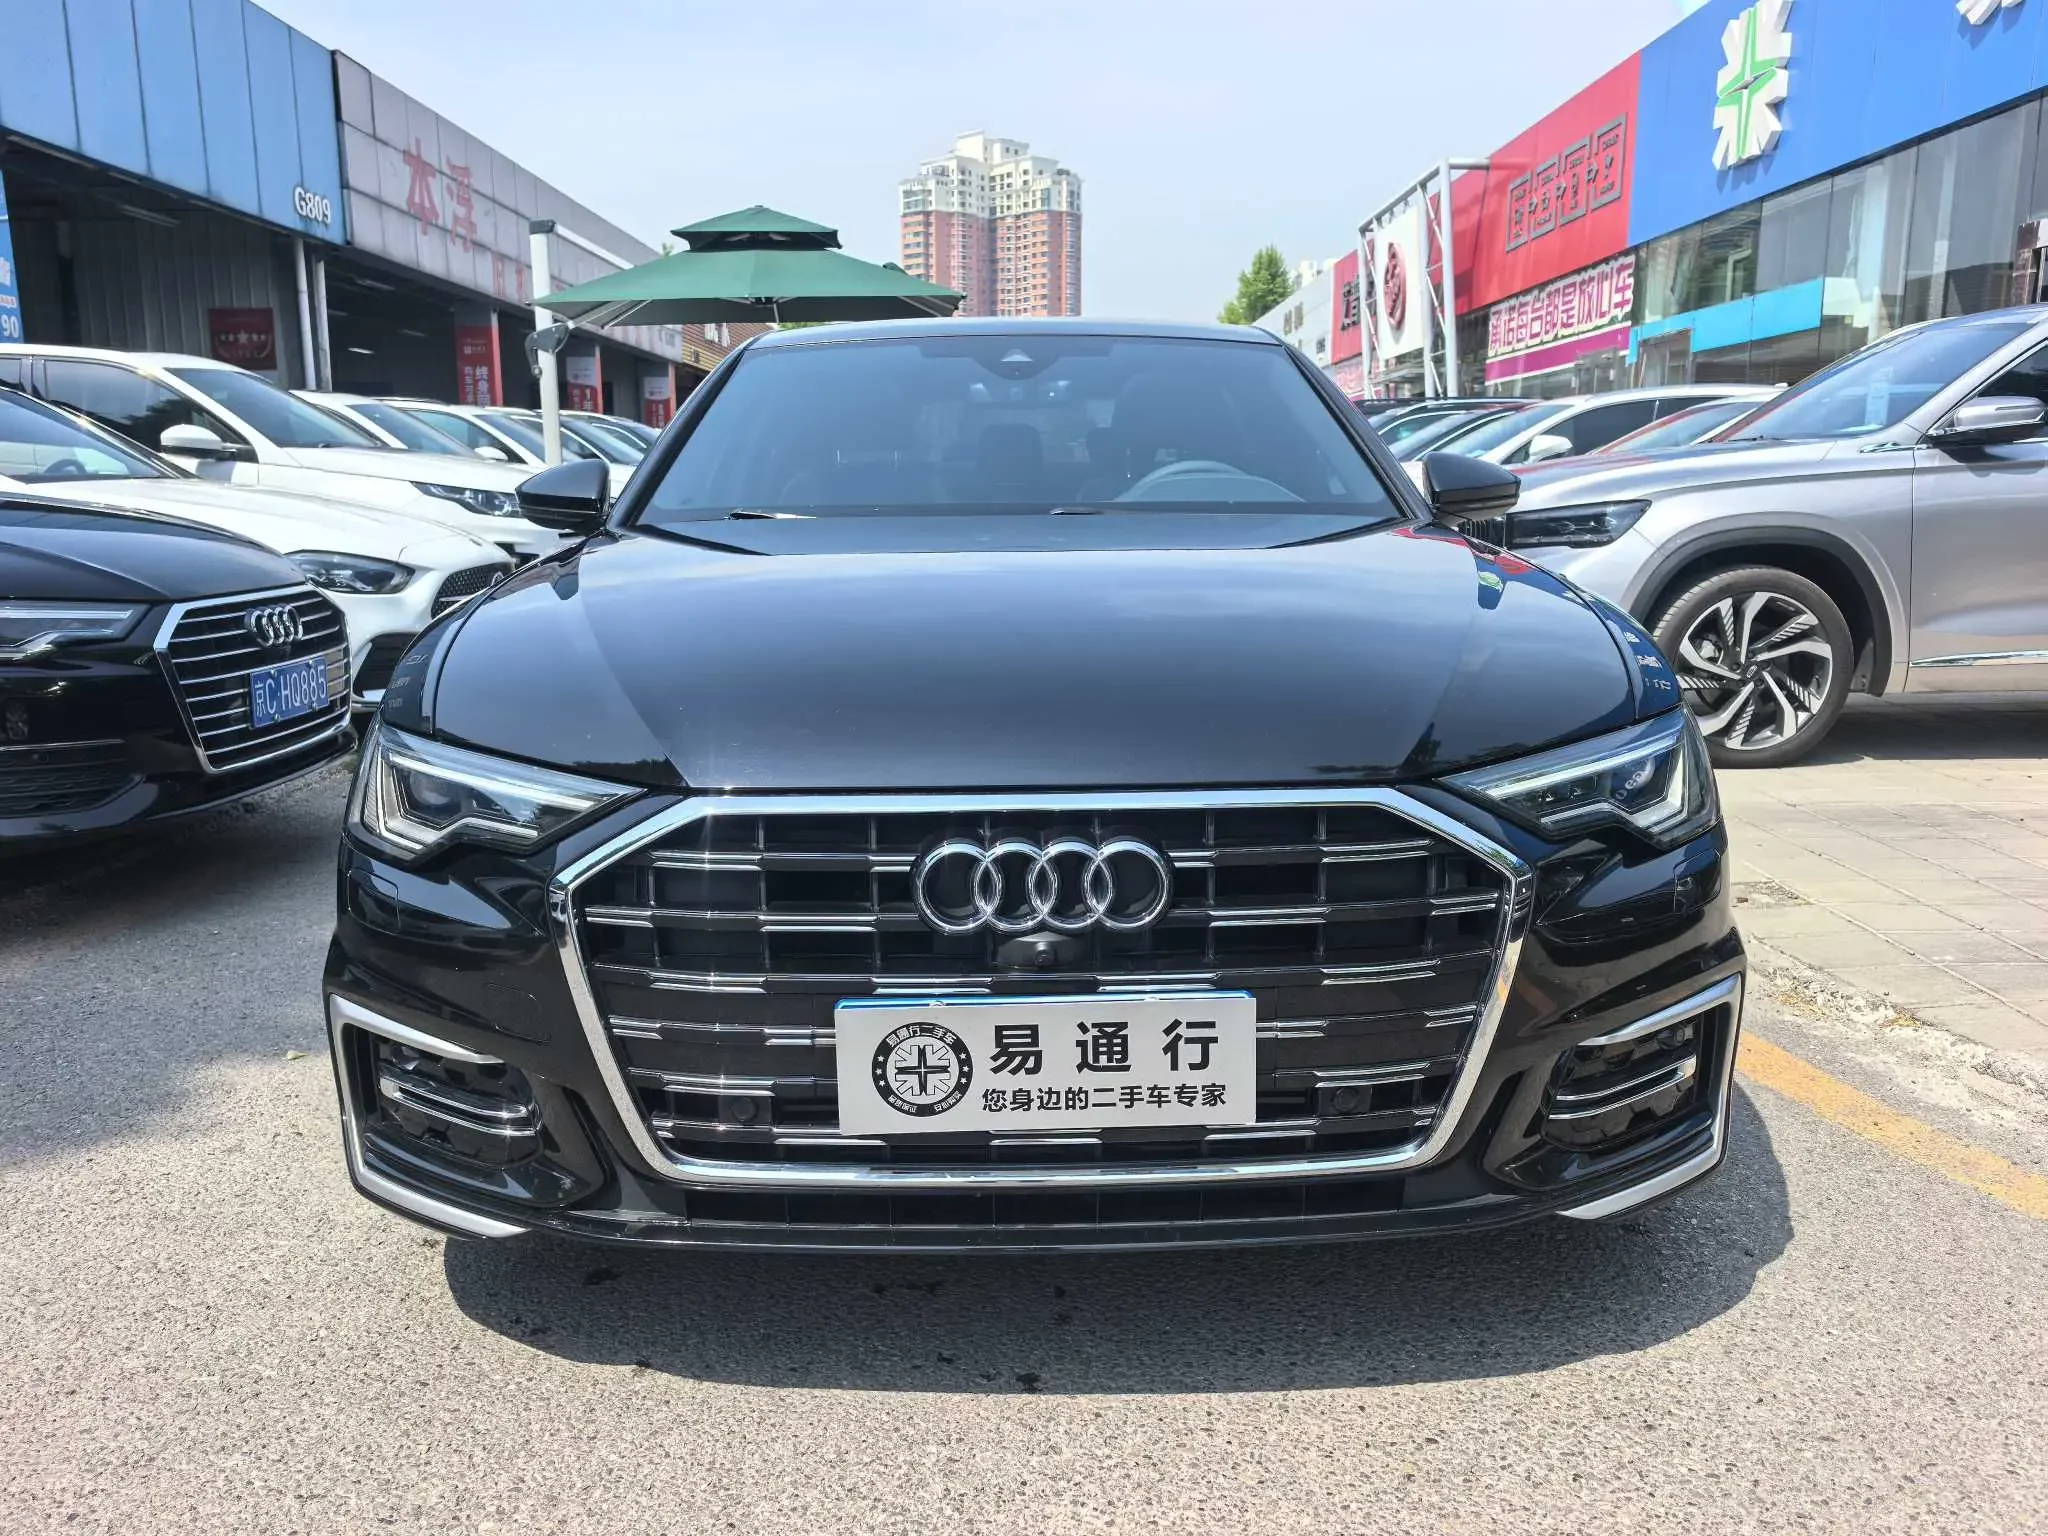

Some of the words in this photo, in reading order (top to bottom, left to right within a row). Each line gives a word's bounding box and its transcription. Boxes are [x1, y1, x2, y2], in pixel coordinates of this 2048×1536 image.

[294, 185, 331, 225] G809
[1490, 258, 1635, 353] 承诺每台都是放心车
[885, 1025, 957, 1048] 易通行二手车
[988, 1018, 1219, 1076] 易通行
[981, 1083, 1227, 1113] 您身边的二手车专家
